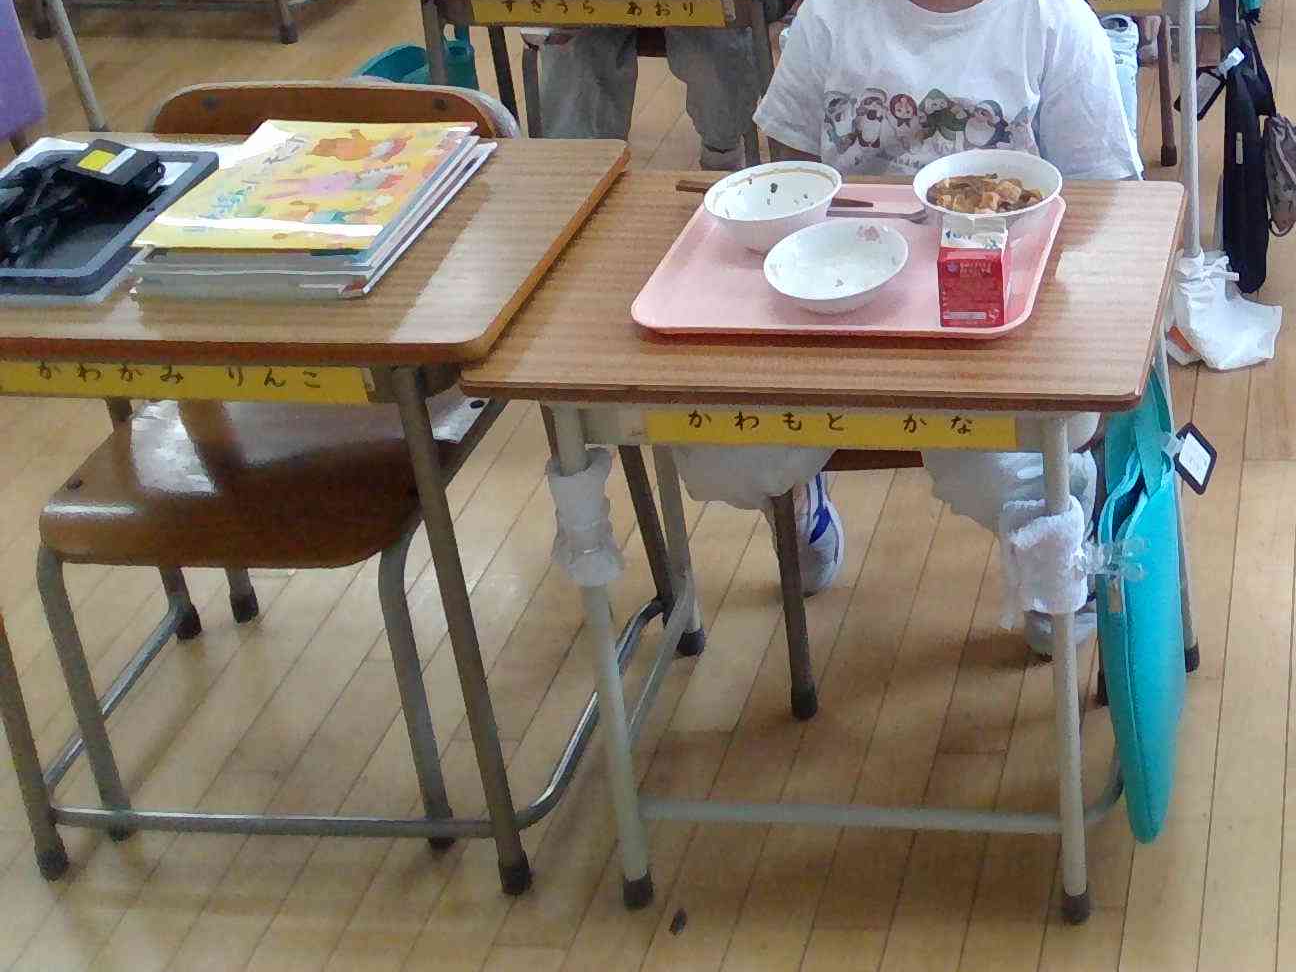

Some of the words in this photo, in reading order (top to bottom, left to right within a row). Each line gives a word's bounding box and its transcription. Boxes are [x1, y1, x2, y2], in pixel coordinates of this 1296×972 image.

[38, 360, 184, 384] かわかみ
[227, 365, 321, 389] りんこ
[688, 412, 847, 431] かわもと
[903, 414, 973, 434] かな
